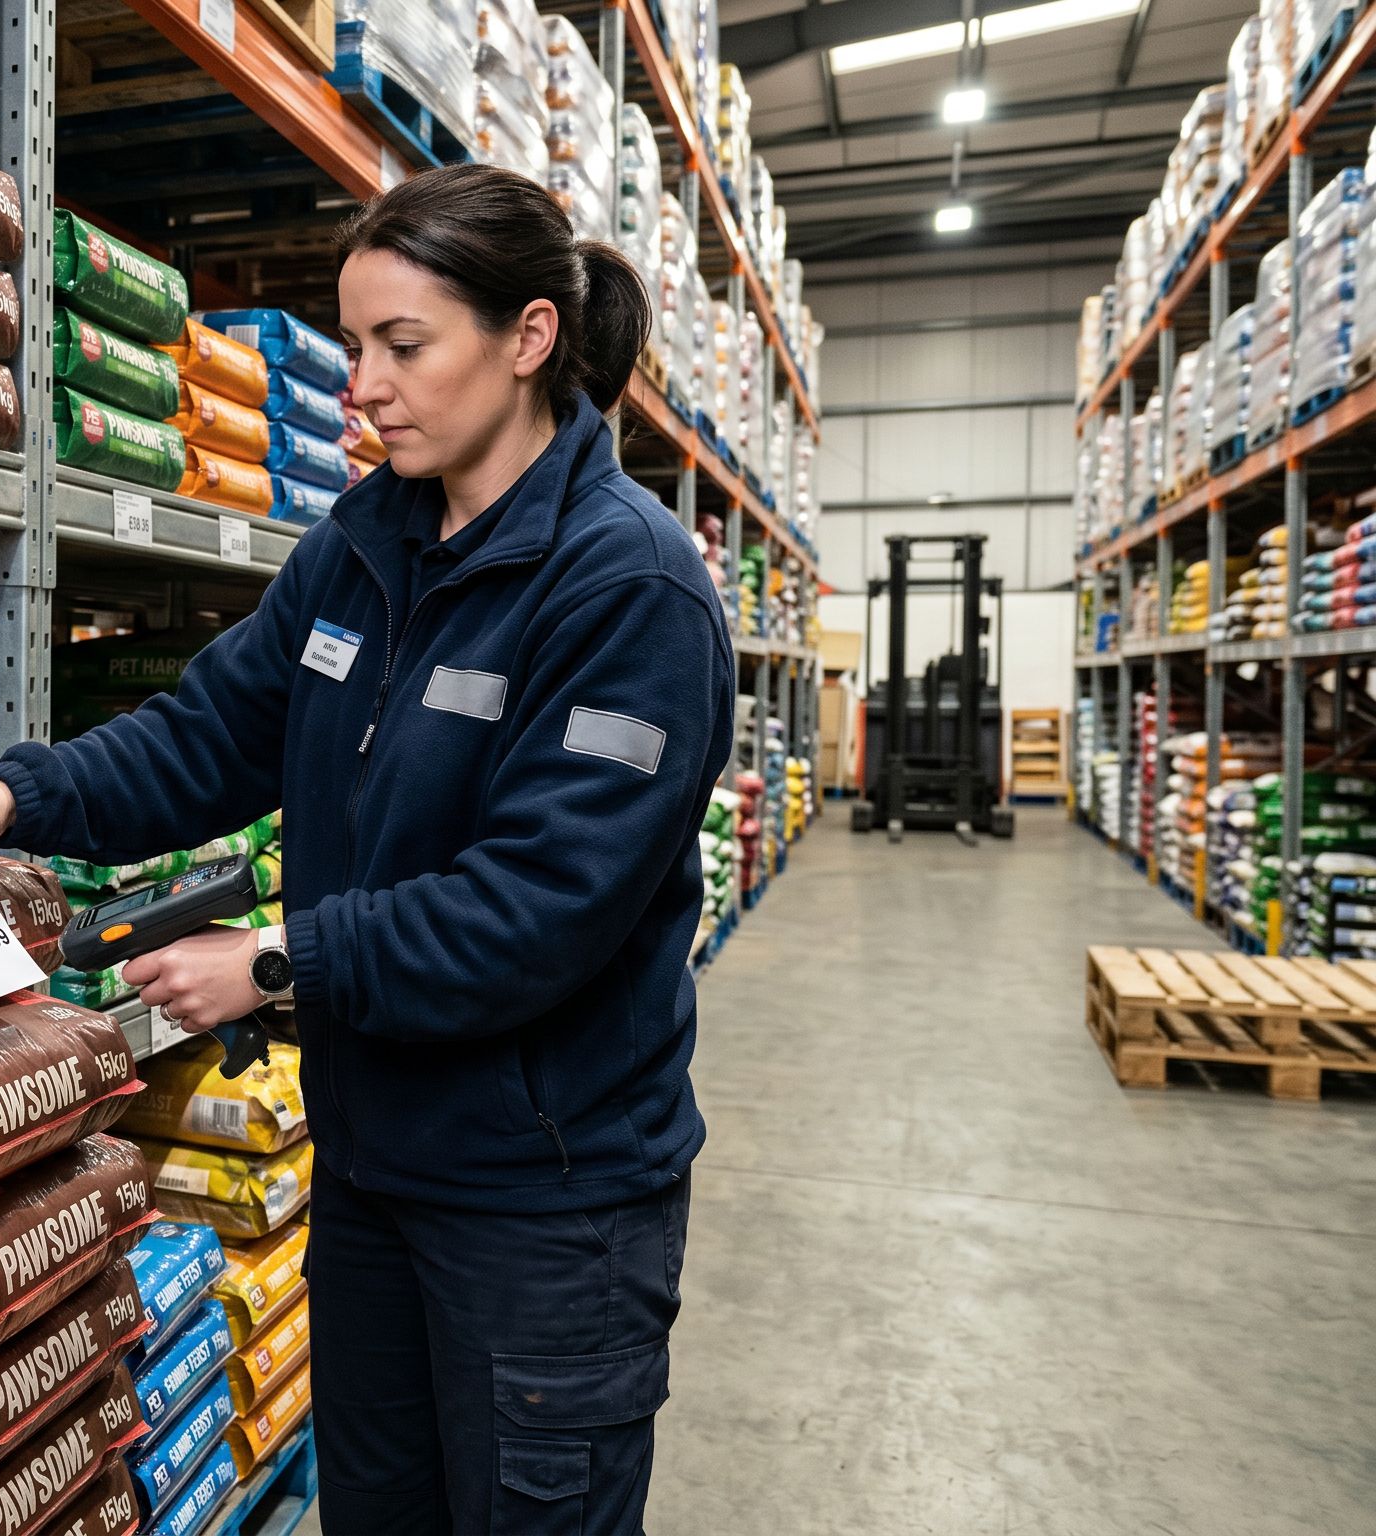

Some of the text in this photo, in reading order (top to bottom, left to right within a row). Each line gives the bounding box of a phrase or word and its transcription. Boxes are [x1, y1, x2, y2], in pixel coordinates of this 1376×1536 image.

[28, 898, 63, 926] 15kg
[95, 1051, 128, 1083] 15kg
[115, 1180, 147, 1214] 15kg
[104, 1292, 136, 1330] 15kg
[98, 1391, 133, 1435] 15kg
[98, 1491, 132, 1532] 15kg
